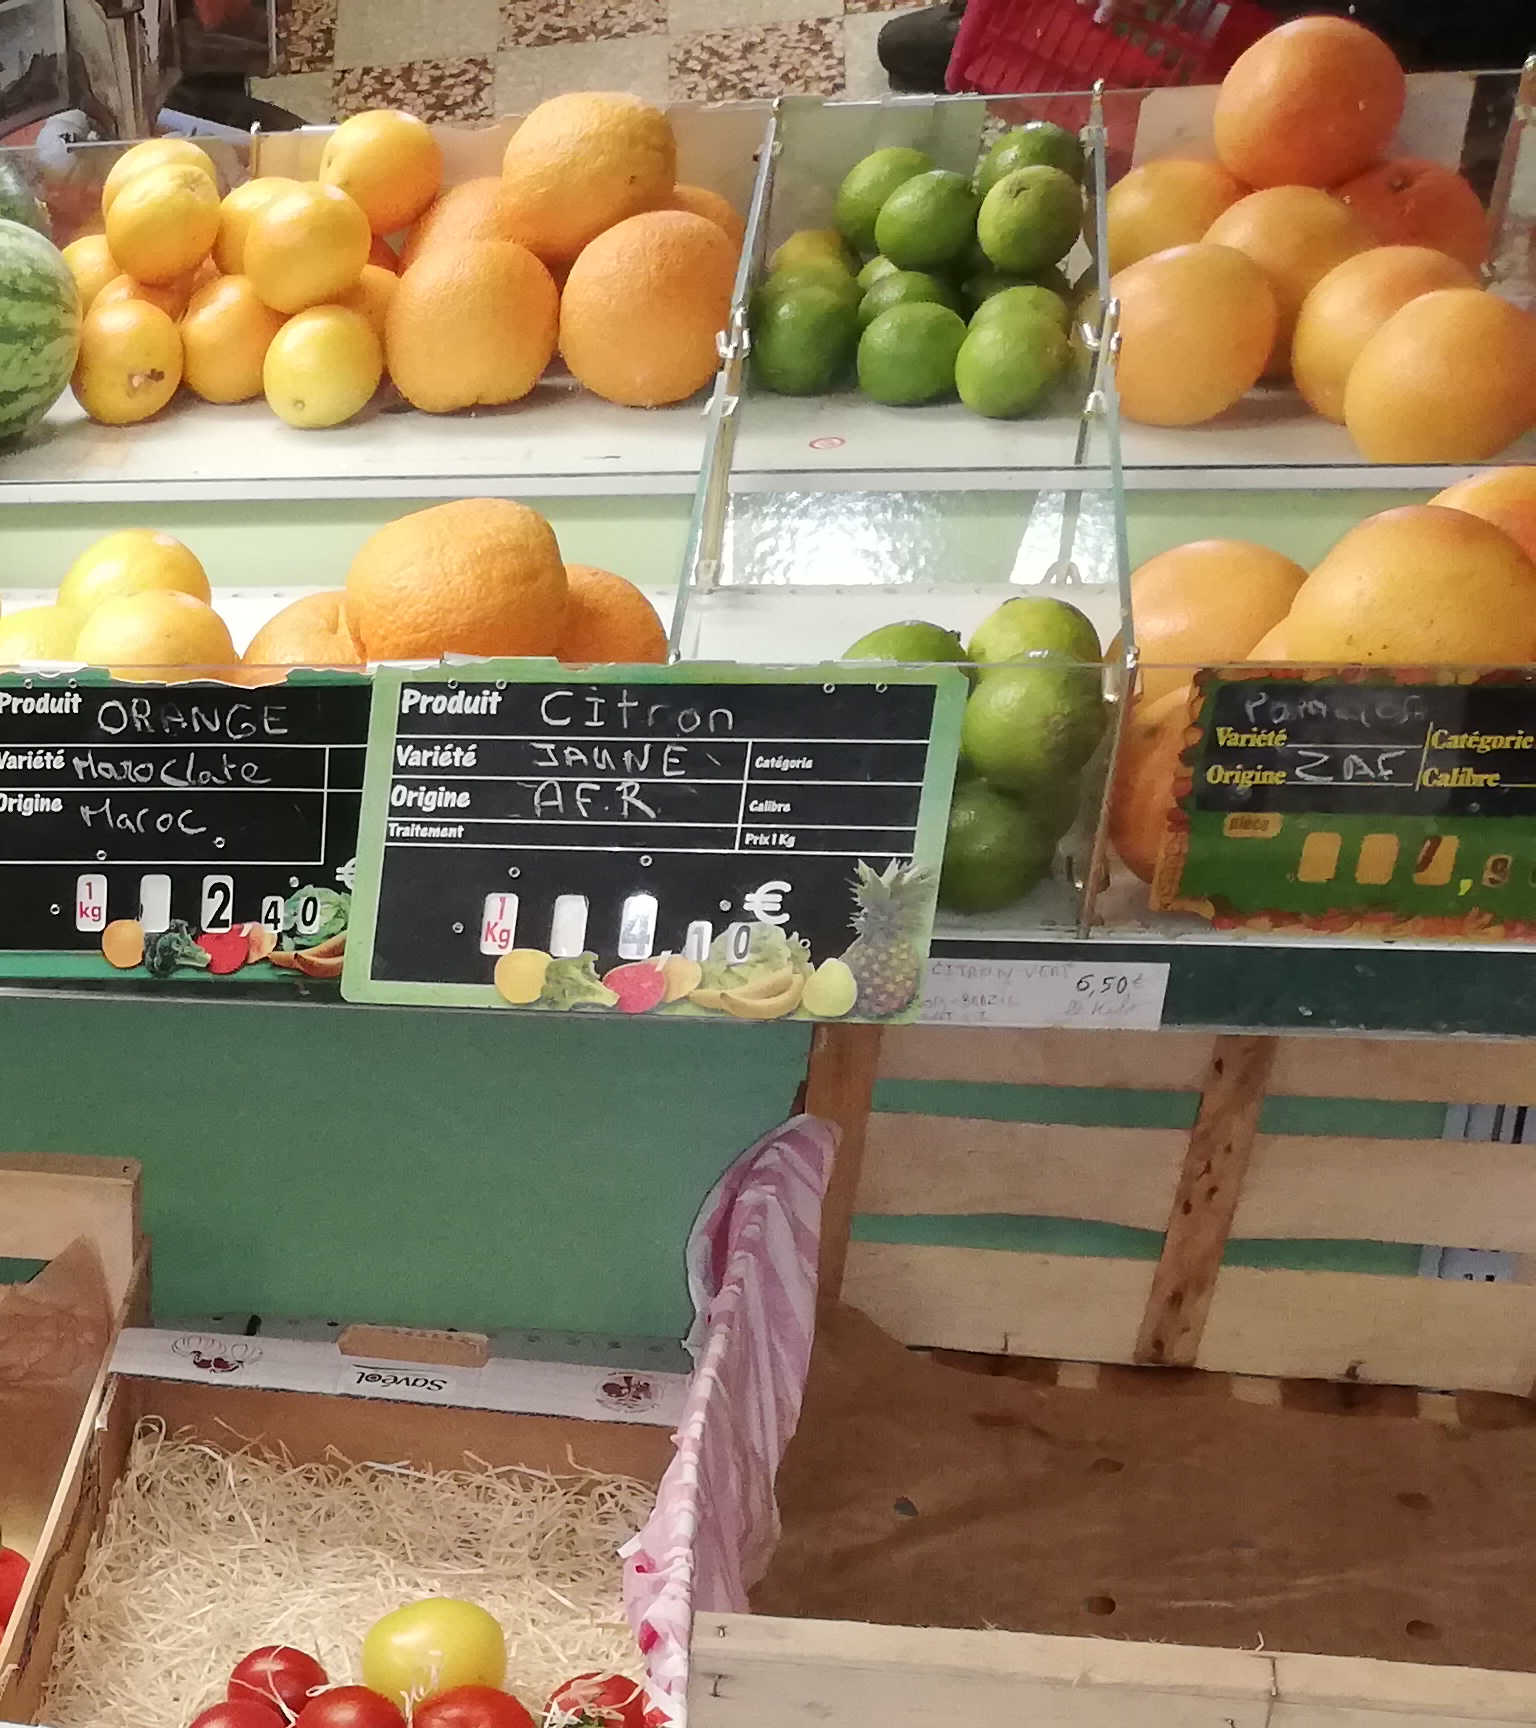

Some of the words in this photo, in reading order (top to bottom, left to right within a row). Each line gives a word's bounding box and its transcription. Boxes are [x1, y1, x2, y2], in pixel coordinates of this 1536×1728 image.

[97, 697, 290, 740] ORANGE
[400, 687, 502, 717] Produit
[539, 686, 734, 738] Citron
[1430, 729, 1534, 753] Catégorie
[396, 745, 478, 770] Variété
[755, 754, 814, 773] Catégorie
[1421, 768, 1502, 789] Calibre
[390, 785, 471, 811] Origine
[749, 799, 792, 815] Calibre
[388, 823, 465, 840] Traitement
[355, 1370, 447, 1393] Savéol
